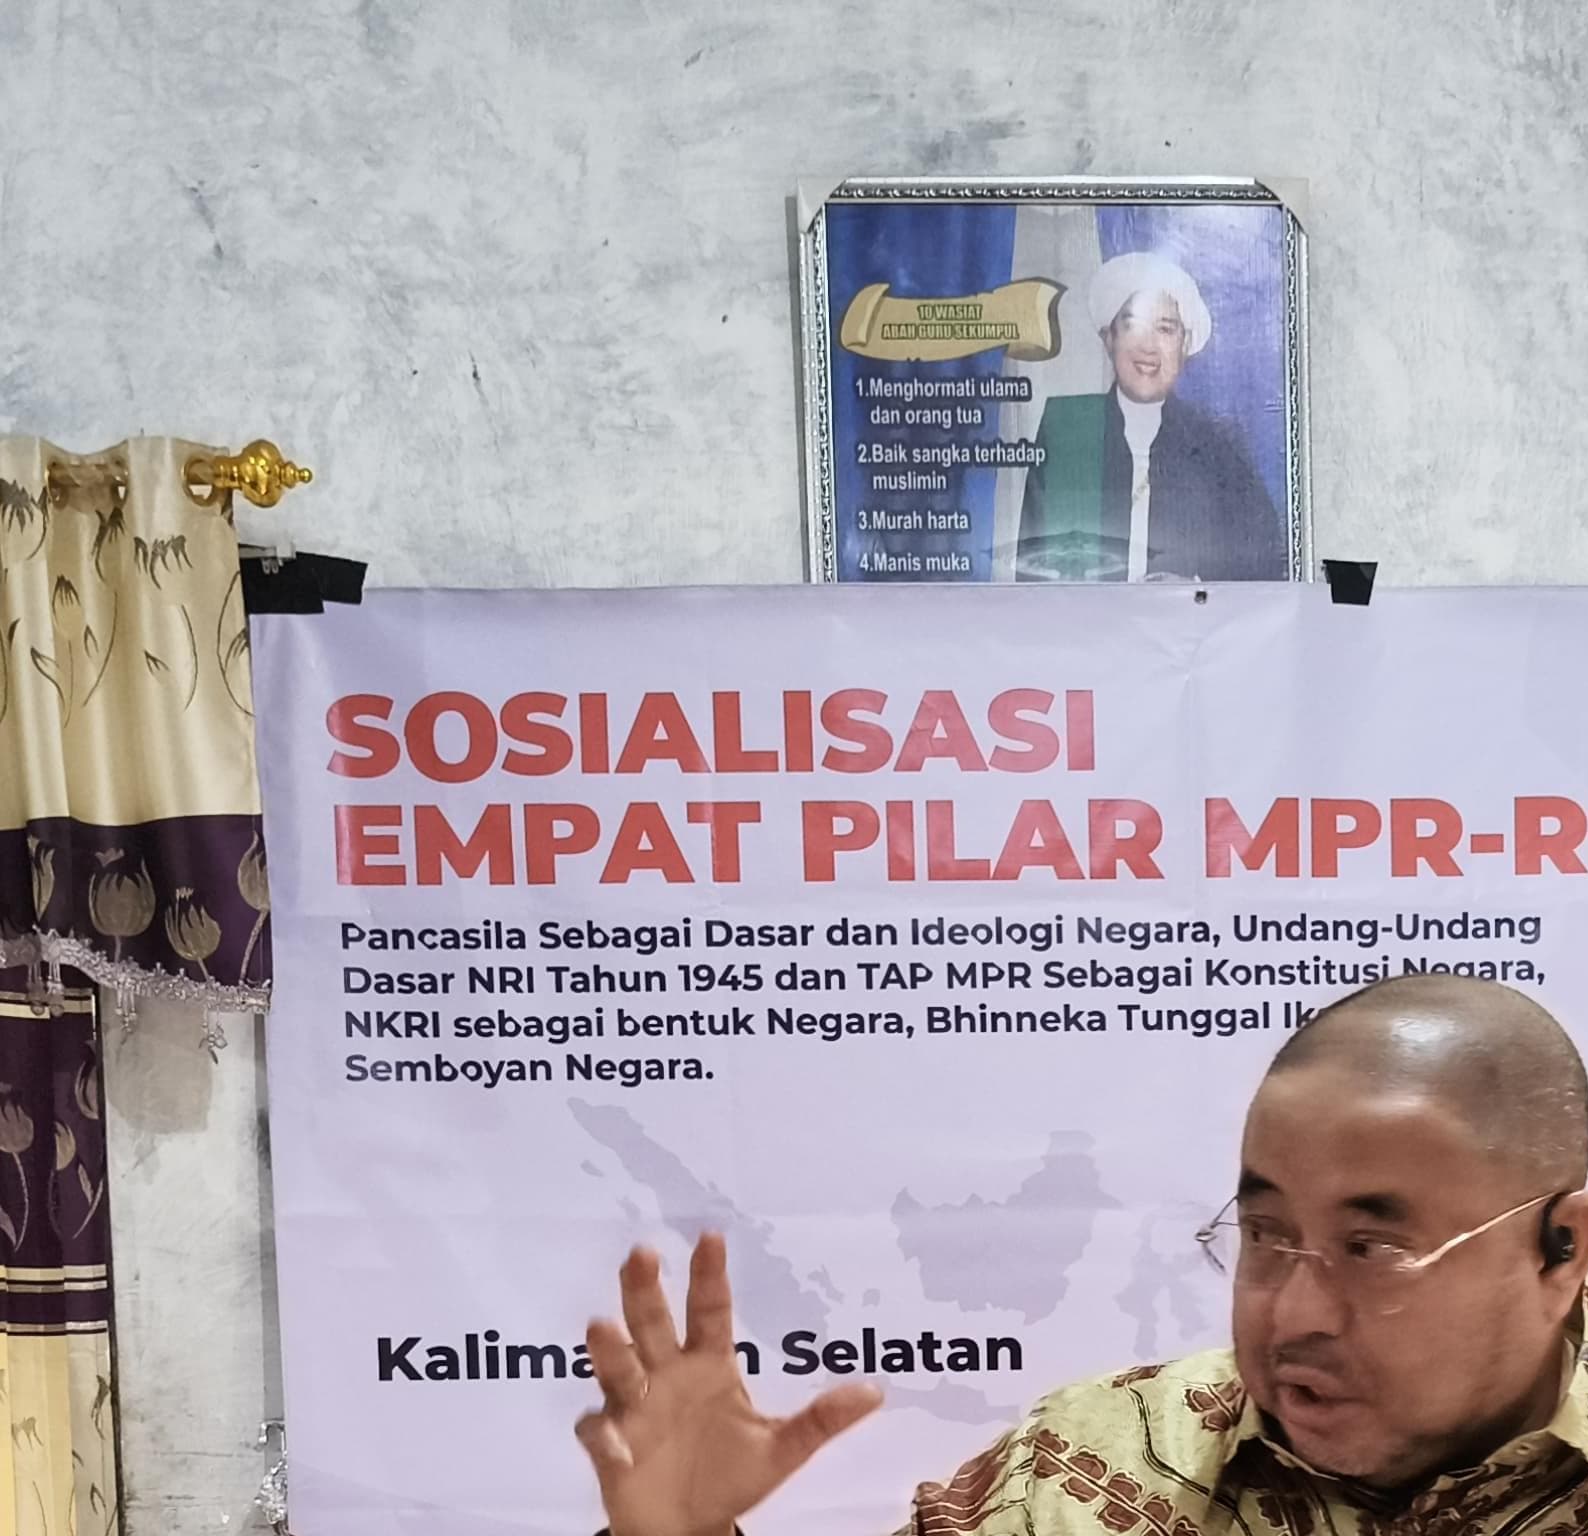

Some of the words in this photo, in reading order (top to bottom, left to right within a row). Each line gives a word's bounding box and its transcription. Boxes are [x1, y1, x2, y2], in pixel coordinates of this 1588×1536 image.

[856, 378, 975, 400] 1.Menghormati
[981, 379, 1029, 397] ulama
[870, 405, 901, 425] dan
[905, 409, 951, 429] orang
[956, 406, 982, 424] tua
[857, 443, 908, 463] 2.Baik
[912, 443, 971, 468] sangka
[975, 444, 1046, 466] terhadap
[872, 470, 947, 490] muslimin
[858, 510, 923, 530] 3.Murah
[927, 510, 969, 530] harta
[860, 554, 921, 571] 4.Manis
[926, 552, 970, 572] muka
[326, 688, 1095, 784] SOSIALISASI
[334, 801, 762, 886] EMPAT
[802, 798, 1165, 883] PILAR
[341, 919, 527, 951] Pancasila
[539, 916, 692, 956] Sebagai
[705, 919, 815, 948] Dasar
[826, 917, 898, 947] dan
[911, 914, 1064, 952] Ideologi
[1077, 916, 1221, 951] Negara,
[1233, 911, 1541, 949] Undang-Undang
[343, 966, 456, 995] Dasar
[468, 966, 535, 994] NRI
[545, 964, 667, 994] Tahun
[677, 963, 764, 992] 1945
[775, 961, 846, 991] dan
[856, 962, 934, 990] TAP
[946, 961, 1032, 990] MPR
[1043, 956, 1193, 995] Sebagai
[1206, 955, 1389, 985] Konstitusi
[345, 1010, 441, 1039] NKRI
[453, 1006, 604, 1045] sebagai
[617, 1006, 756, 1037] bentuk
[767, 1007, 915, 1042] Negara,
[926, 1002, 1107, 1034] Bhinneka
[1117, 1001, 1270, 1038] Tunggal
[1284, 1001, 1318, 1029] Ik
[345, 1053, 553, 1089] Semboyan
[565, 1053, 714, 1088] Negara.
[378, 1331, 760, 1381] Kaliman
[781, 1327, 1023, 1376] Selatan
